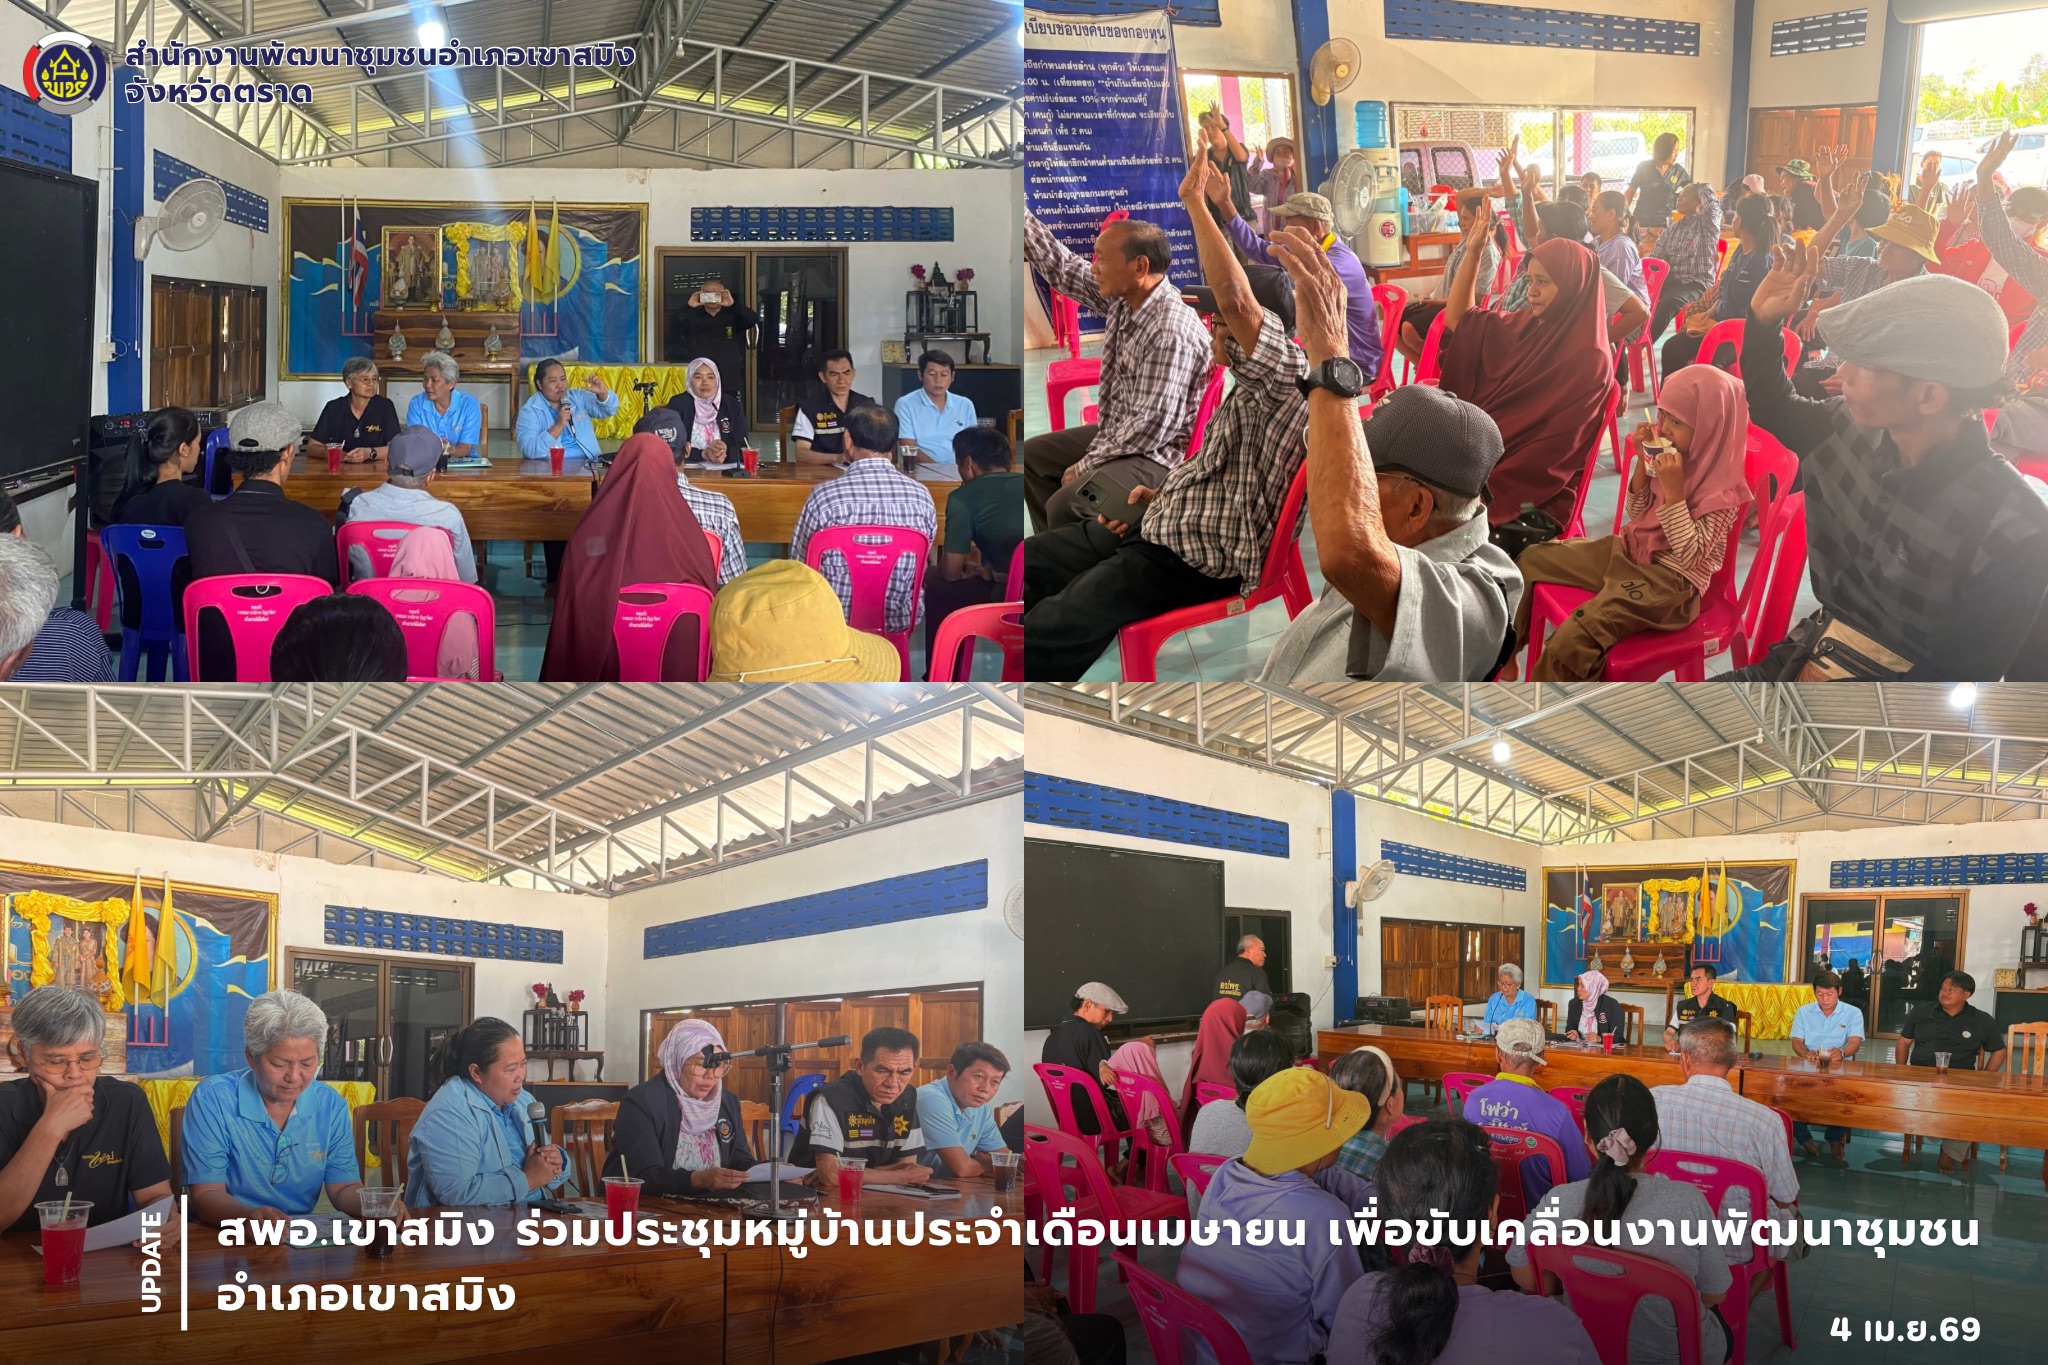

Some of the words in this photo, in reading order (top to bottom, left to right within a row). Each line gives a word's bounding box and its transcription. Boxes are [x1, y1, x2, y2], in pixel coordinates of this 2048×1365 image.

[1071, 127, 1077, 135] 2
[1165, 156, 1170, 164] 2
[1619, 580, 1647, 601] alo
[1479, 1097, 1519, 1120] โฟว่า
